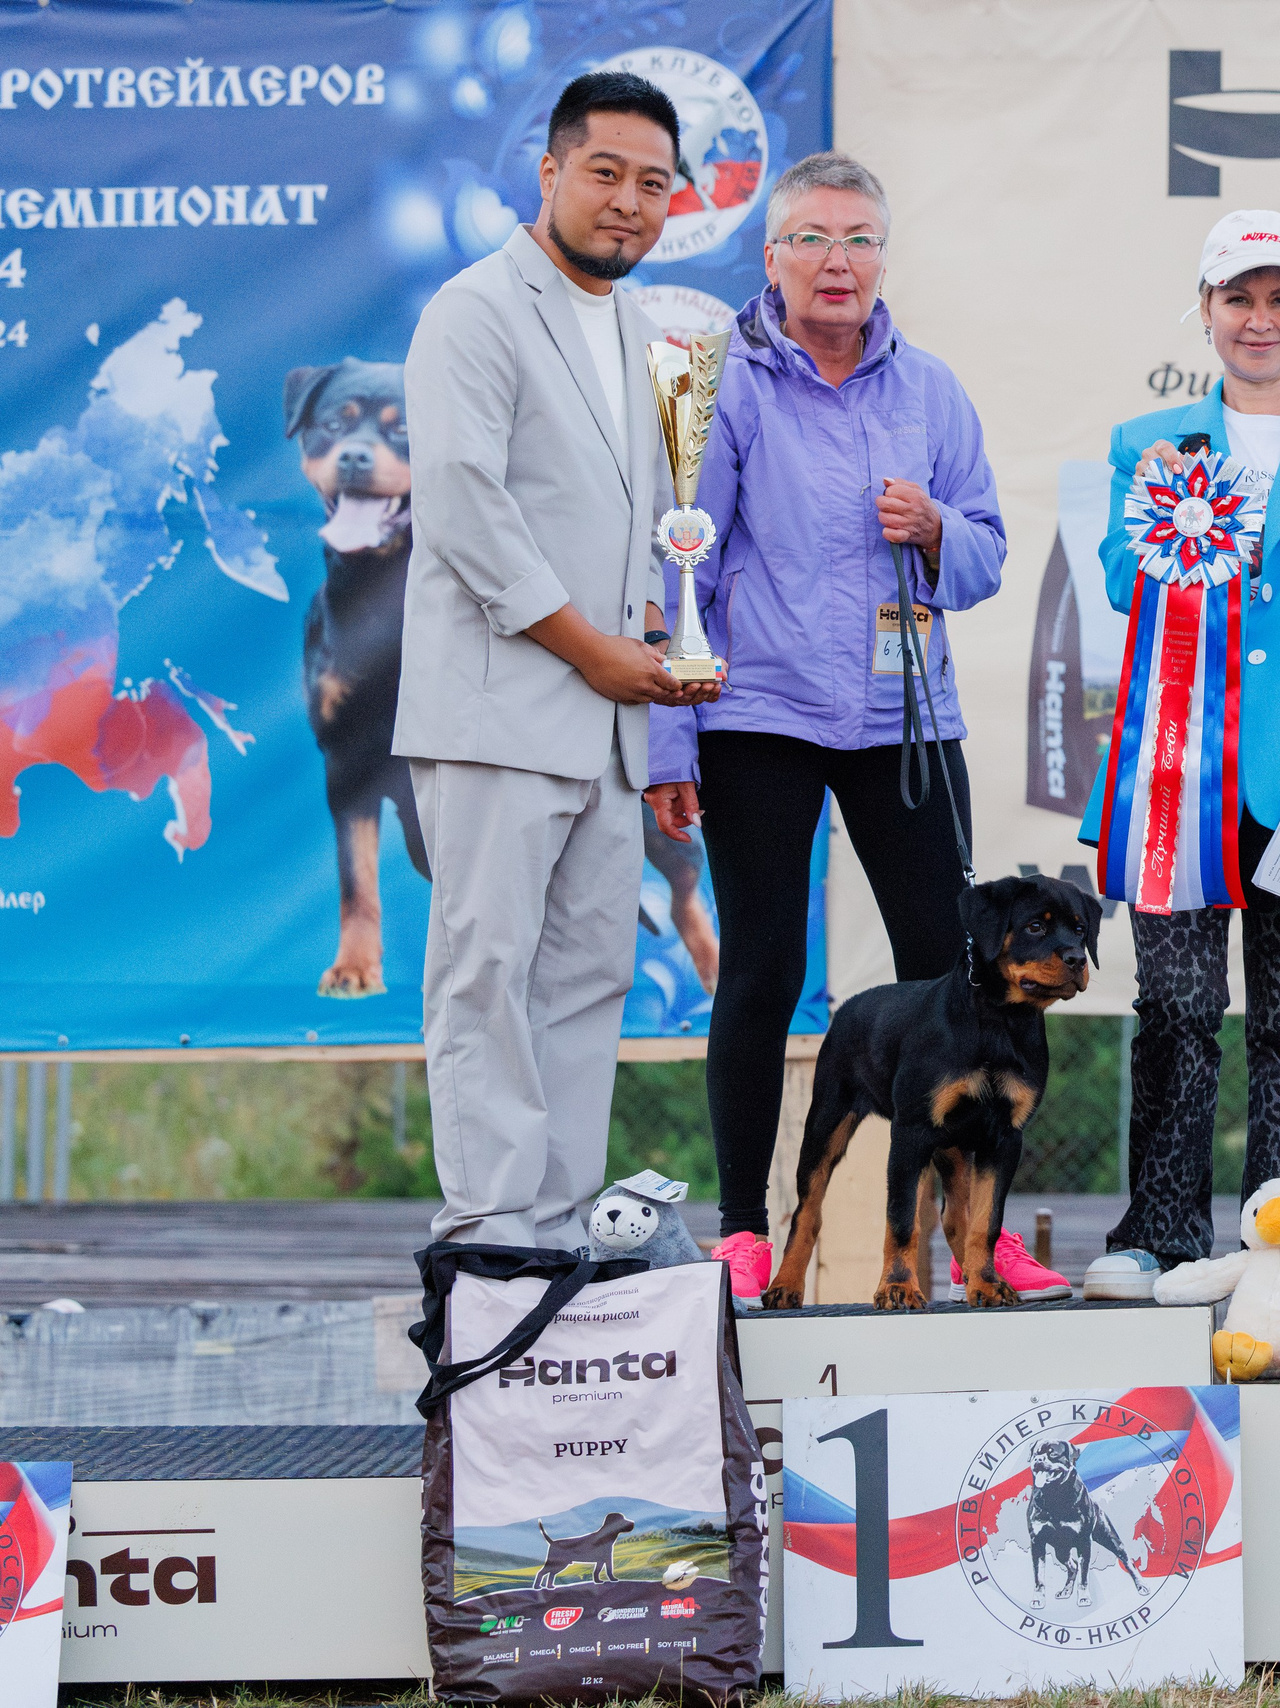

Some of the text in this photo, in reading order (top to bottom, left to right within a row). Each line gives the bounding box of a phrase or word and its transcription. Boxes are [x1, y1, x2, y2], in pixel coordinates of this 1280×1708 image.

[0, 57, 385, 110] РОТВЕЙЛЕРОВ
[0, 184, 328, 229] ЕМПИОНАТ
[880, 608, 928, 622] Hata
[1045, 659, 1066, 799] Hanta
[553, 1311, 591, 1323] рицей
[602, 1310, 639, 1322] рисом
[499, 1350, 677, 1388] Hanta
[819, 1364, 837, 1396] 1
[552, 1391, 623, 1404] premium
[553, 1438, 628, 1458] PUPPY
[960, 1404, 1201, 1586] РОТВЕЙЛЕР КЛУБ РОССИИ
[816, 1408, 924, 1649] 1
[66, 1547, 217, 1607] nta
[550, 1617, 570, 1626] MEAT
[551, 1610, 576, 1618] FRESH
[1018, 1606, 1153, 1645] РКФ-НКПР
[483, 1652, 514, 1662] BALANCE
[529, 1648, 556, 1656] OMEGA
[569, 1645, 596, 1654] OMEGA
[581, 1677, 592, 1685] 12
